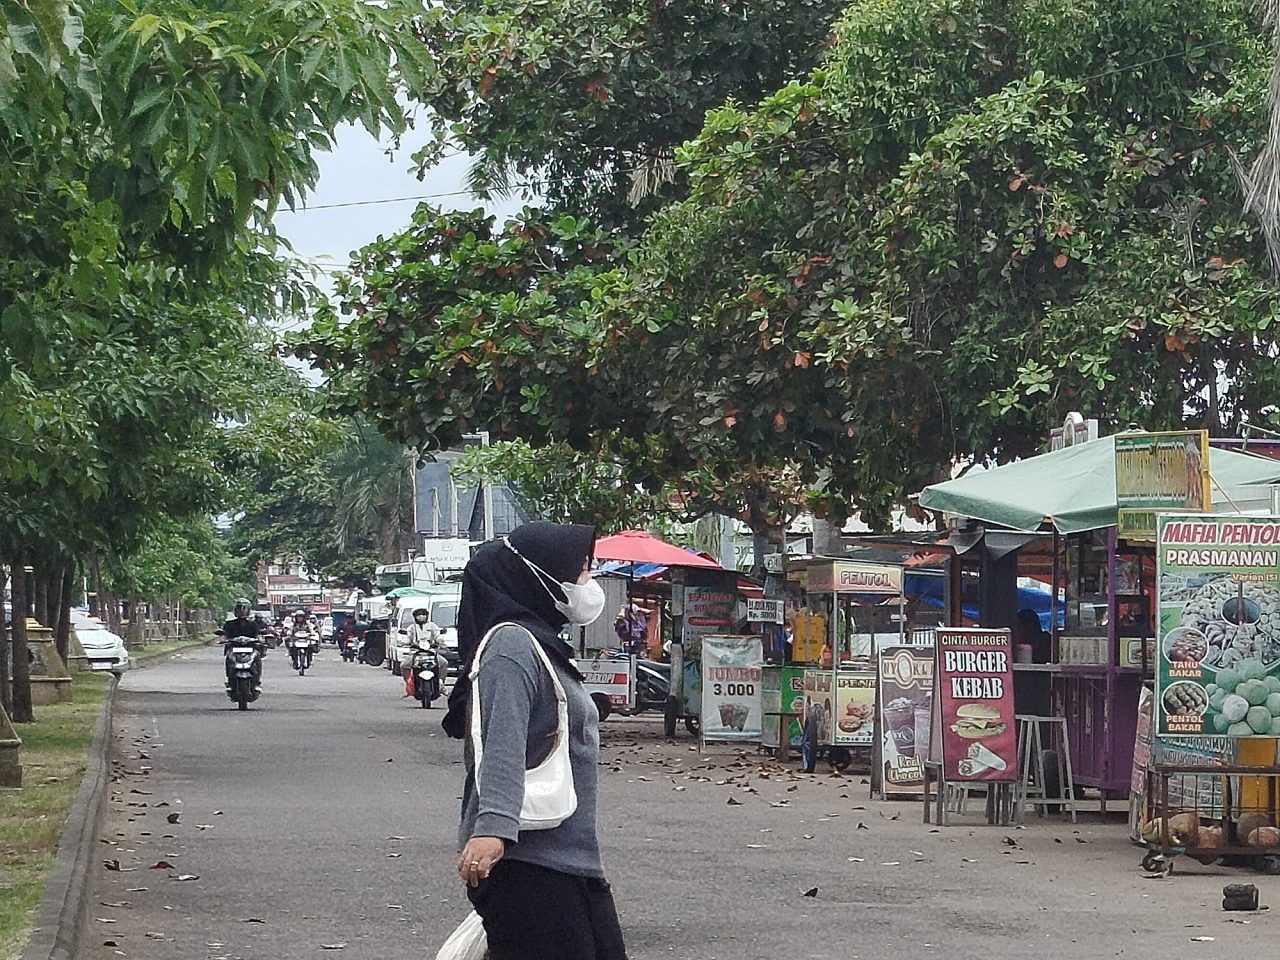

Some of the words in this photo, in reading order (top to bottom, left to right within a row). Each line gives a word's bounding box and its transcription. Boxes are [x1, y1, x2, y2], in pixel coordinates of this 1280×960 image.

[1163, 523, 1217, 543] MAFIA
[1166, 550, 1277, 567] PRASMANAN
[841, 571, 891, 587] PENTOL
[1232, 572, 1263, 581] Varian
[942, 635, 968, 645] CINTA
[971, 635, 1008, 646] BURGER
[944, 651, 1007, 672] BURGER
[1171, 661, 1199, 669] TAHU
[713, 684, 754, 696] 3.000
[951, 677, 1003, 698] KEBAB
